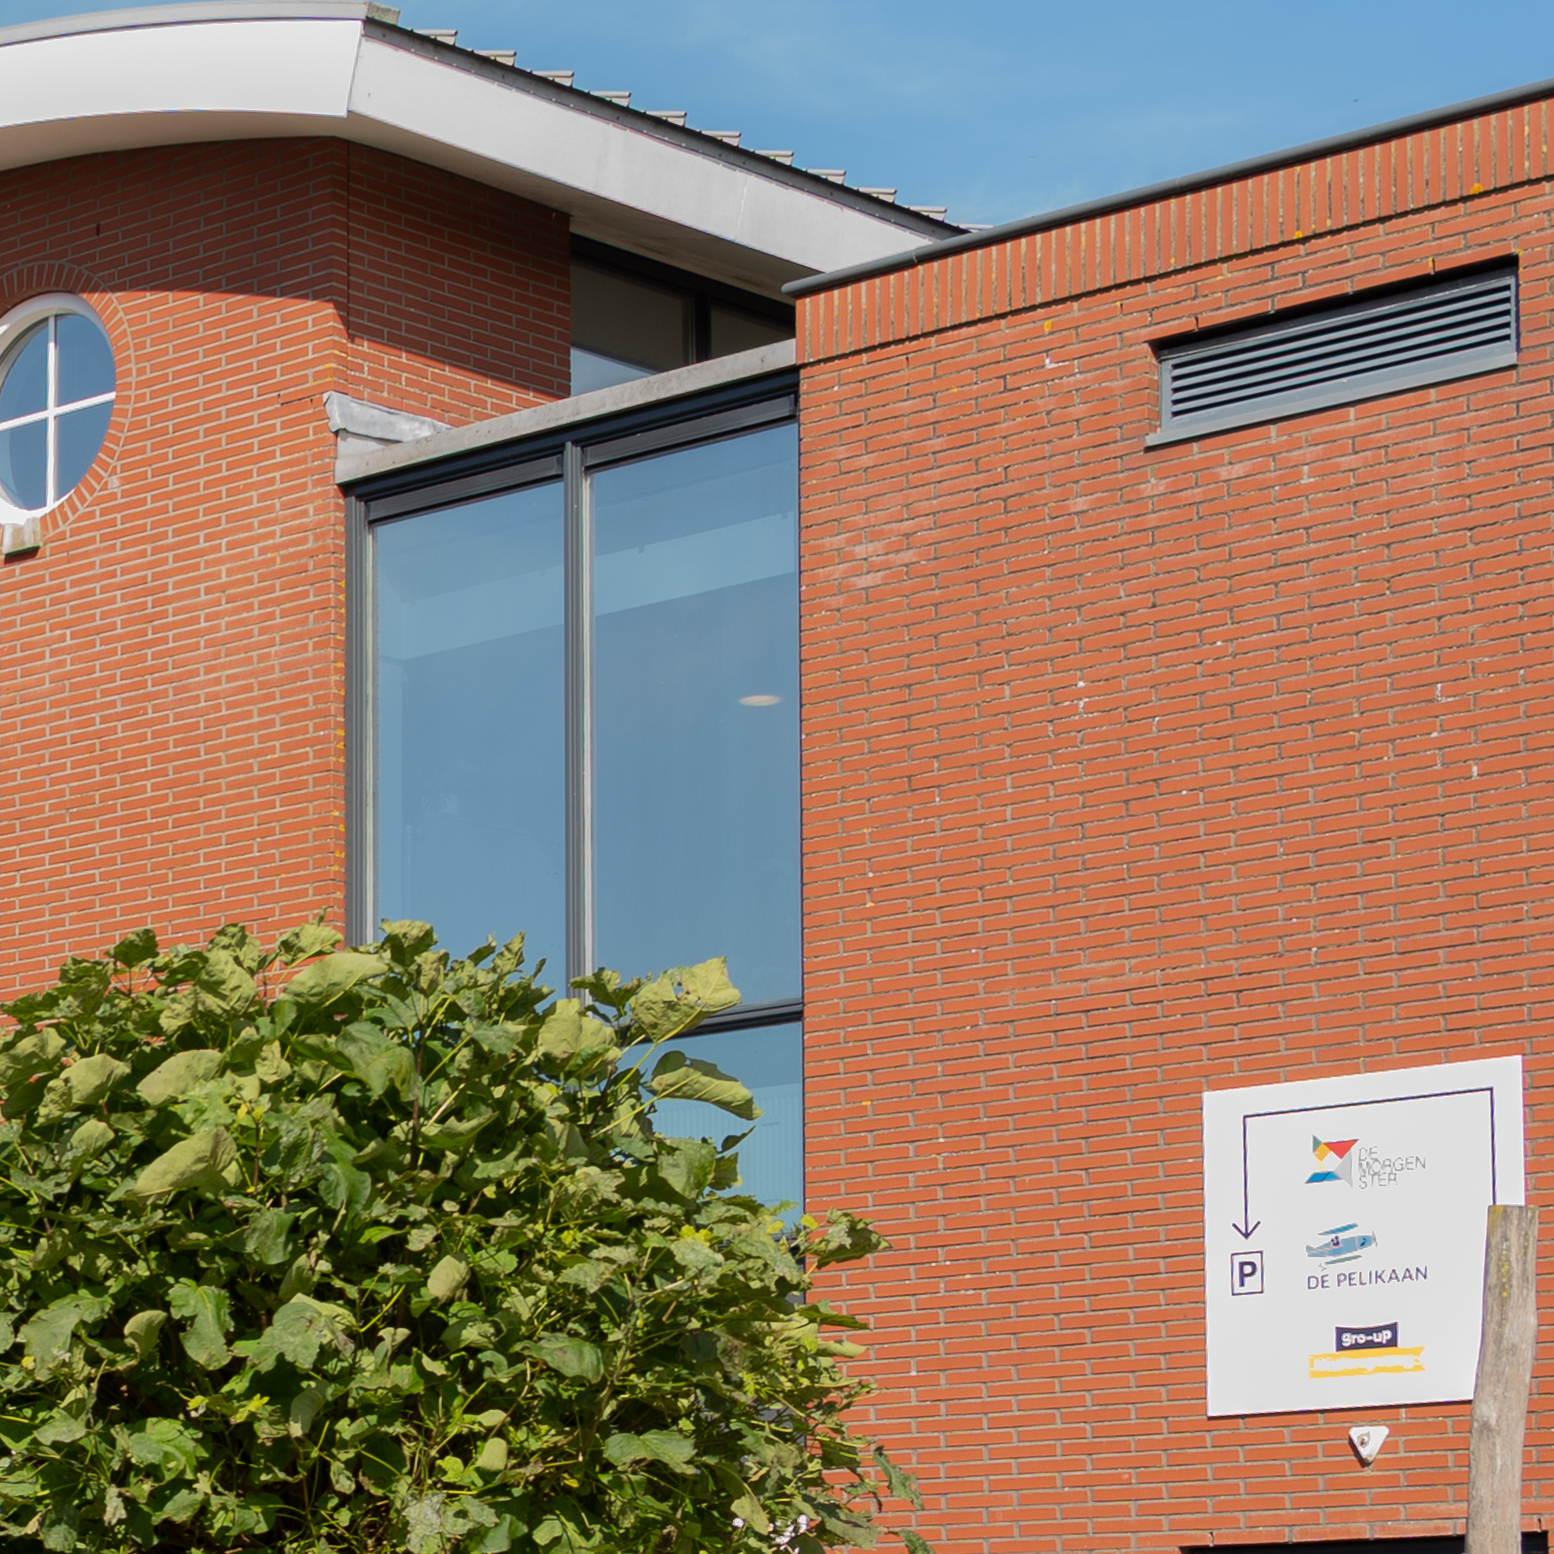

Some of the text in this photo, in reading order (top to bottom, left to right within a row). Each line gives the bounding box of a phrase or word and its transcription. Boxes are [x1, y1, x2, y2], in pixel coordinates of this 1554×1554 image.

[1358, 1146, 1378, 1161] DE
[1358, 1155, 1426, 1175] MORGEN
[1358, 1172, 1399, 1190] STER
[1238, 1261, 1257, 1288] P
[1307, 1265, 1428, 1290] DE PELIKAAN
[1341, 1329, 1392, 1347] gro-up
